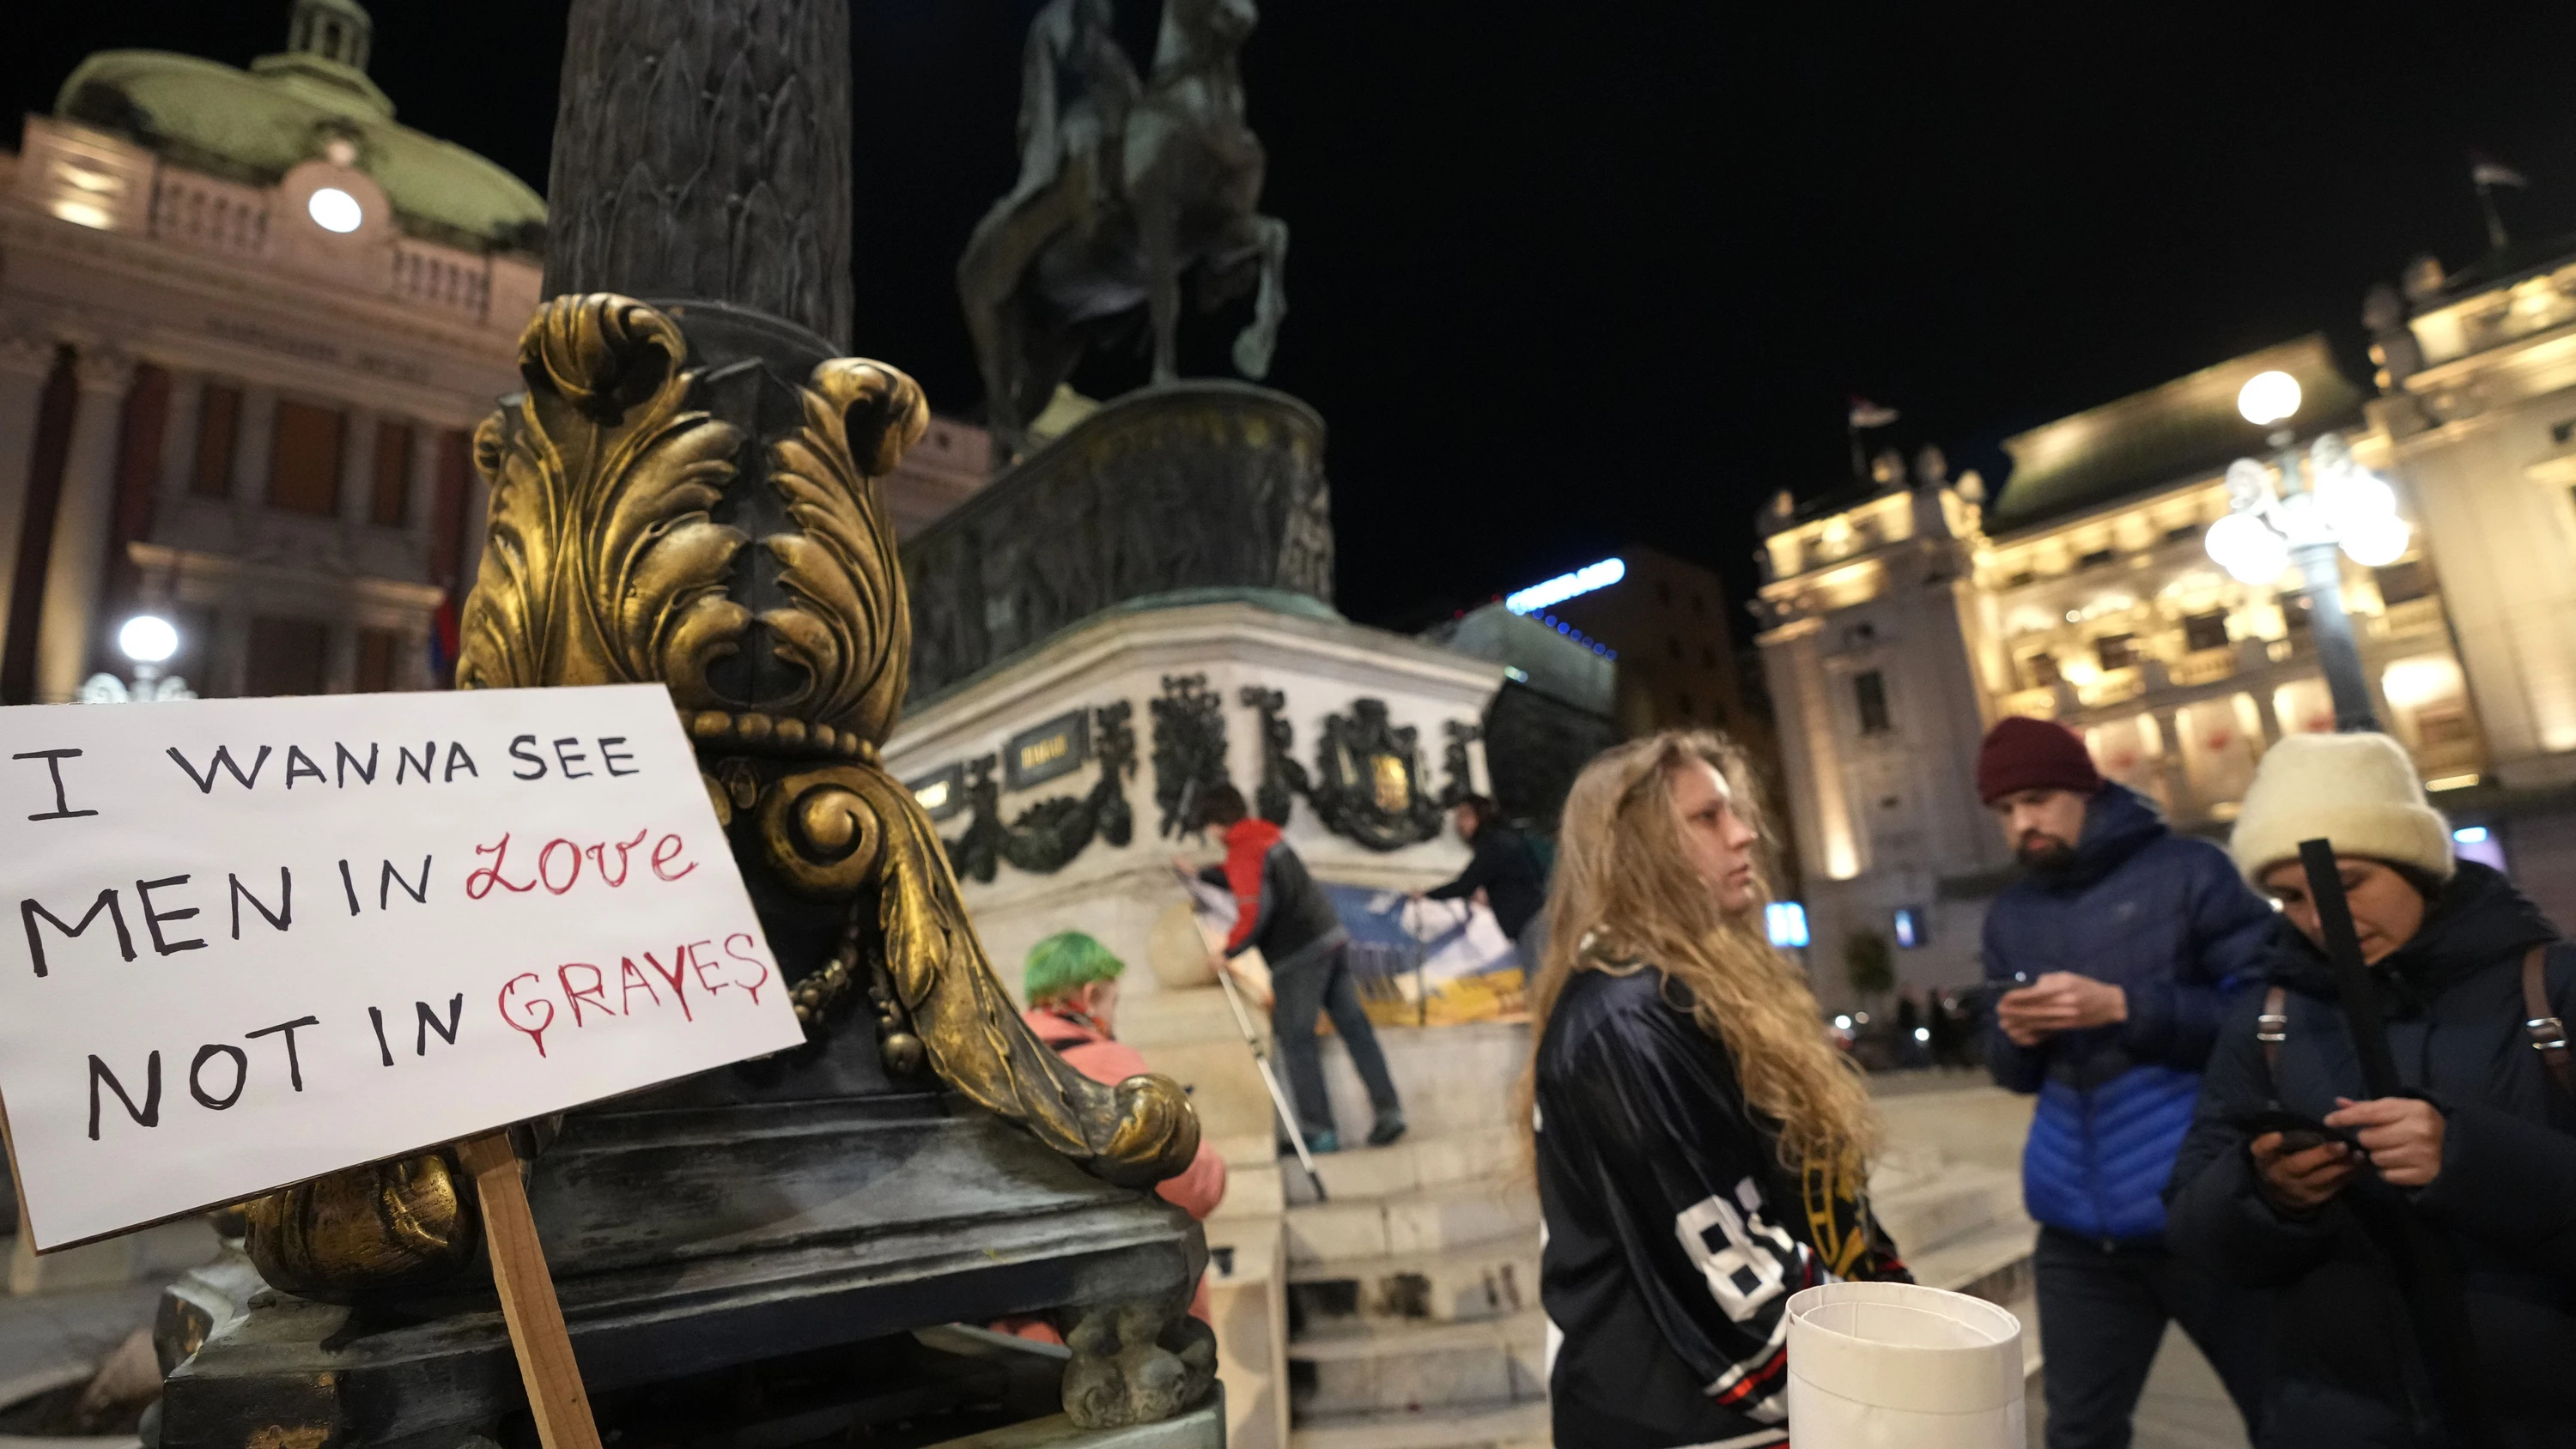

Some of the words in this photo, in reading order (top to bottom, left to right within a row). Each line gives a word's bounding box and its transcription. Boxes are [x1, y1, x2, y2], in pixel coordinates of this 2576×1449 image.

[12, 748, 99, 821] I
[167, 742, 478, 794] WANNA
[508, 735, 640, 780] SEE
[21, 866, 292, 978] MEN
[338, 854, 432, 916] IN
[88, 1015, 319, 1141] NOT
[368, 992, 464, 1066] IN
